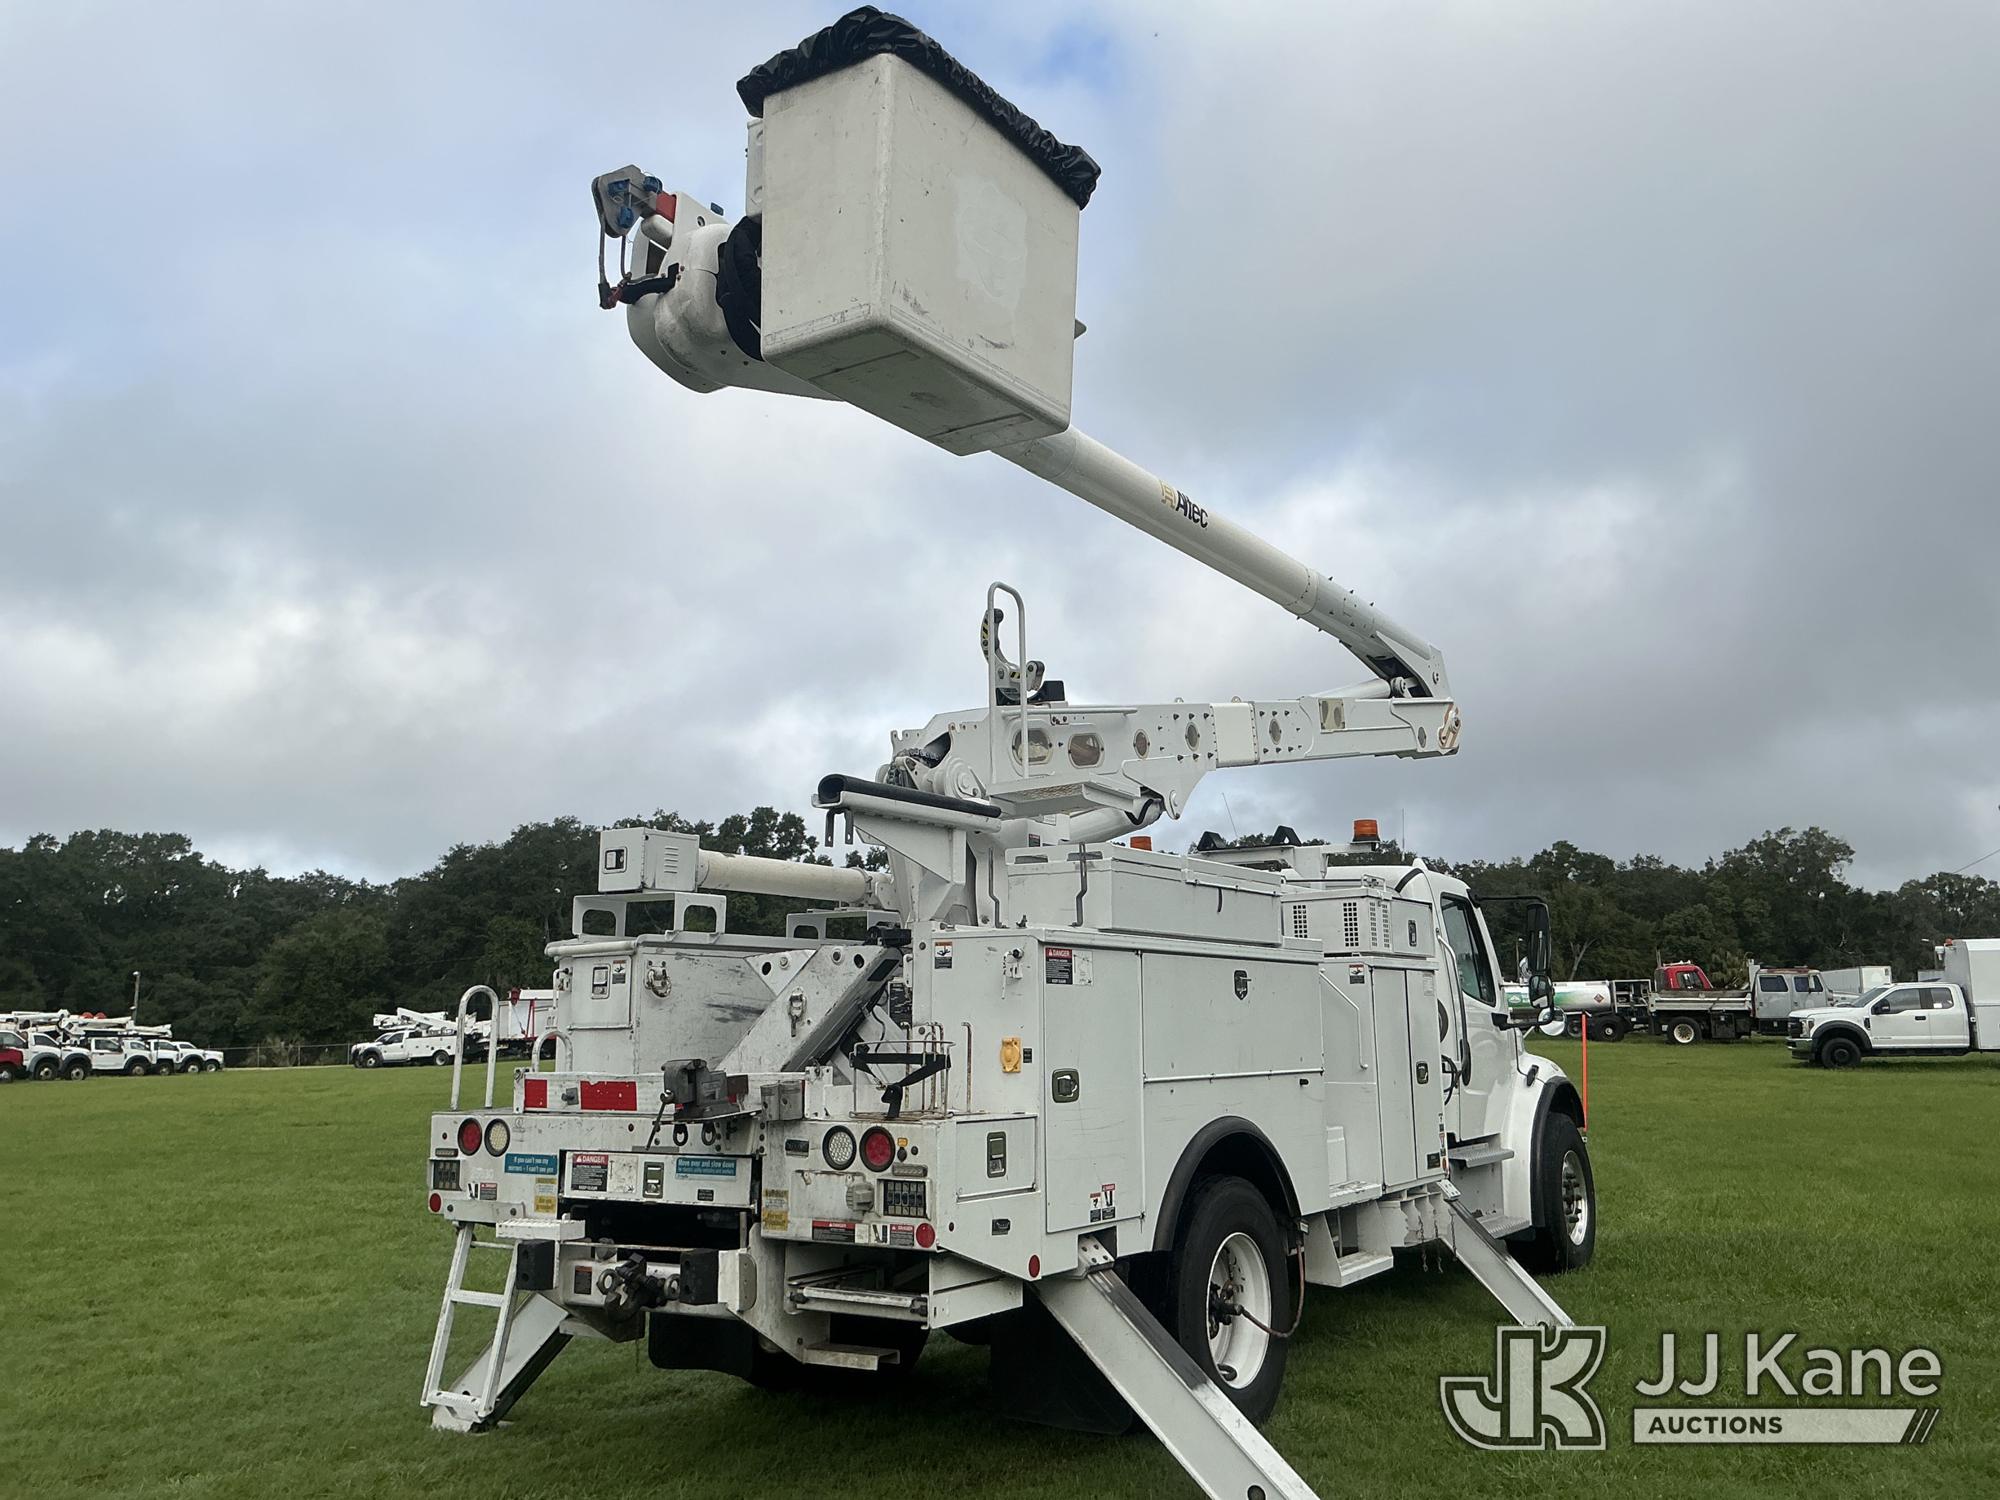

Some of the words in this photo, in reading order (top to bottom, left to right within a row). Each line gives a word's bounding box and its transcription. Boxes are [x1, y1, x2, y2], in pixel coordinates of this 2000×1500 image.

[1176, 490, 1208, 528] Altec
[678, 1159, 690, 1167] Move
[722, 1161, 735, 1169] down
